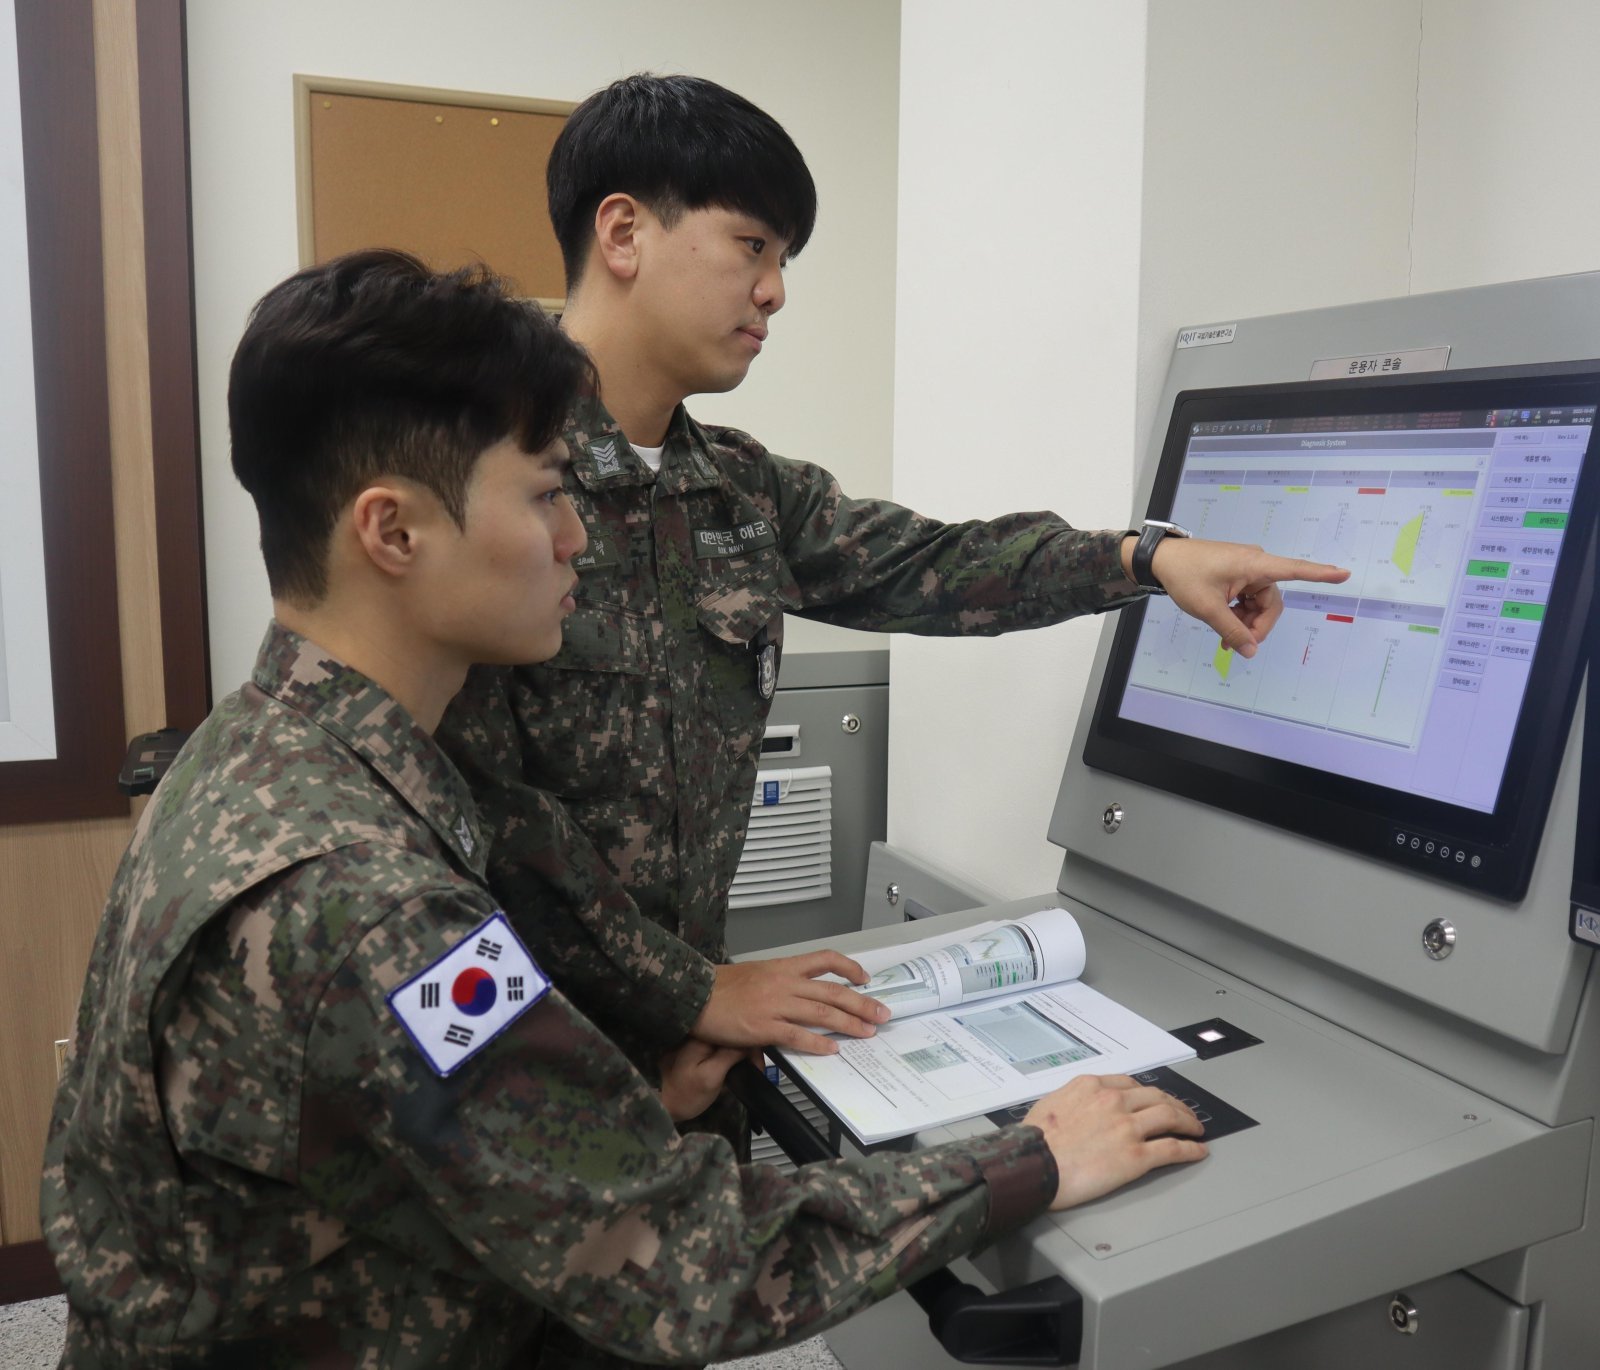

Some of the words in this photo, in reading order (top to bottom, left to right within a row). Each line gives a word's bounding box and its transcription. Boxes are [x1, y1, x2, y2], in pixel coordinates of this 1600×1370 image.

[1348, 360, 1377, 374] 운용자
[1382, 358, 1402, 371] 콘솔
[1301, 439, 1325, 449] Diagnosis
[1327, 439, 1346, 449] System
[699, 530, 735, 546] 대한민국
[738, 520, 768, 540] 해군
[728, 543, 745, 554] NAVY
